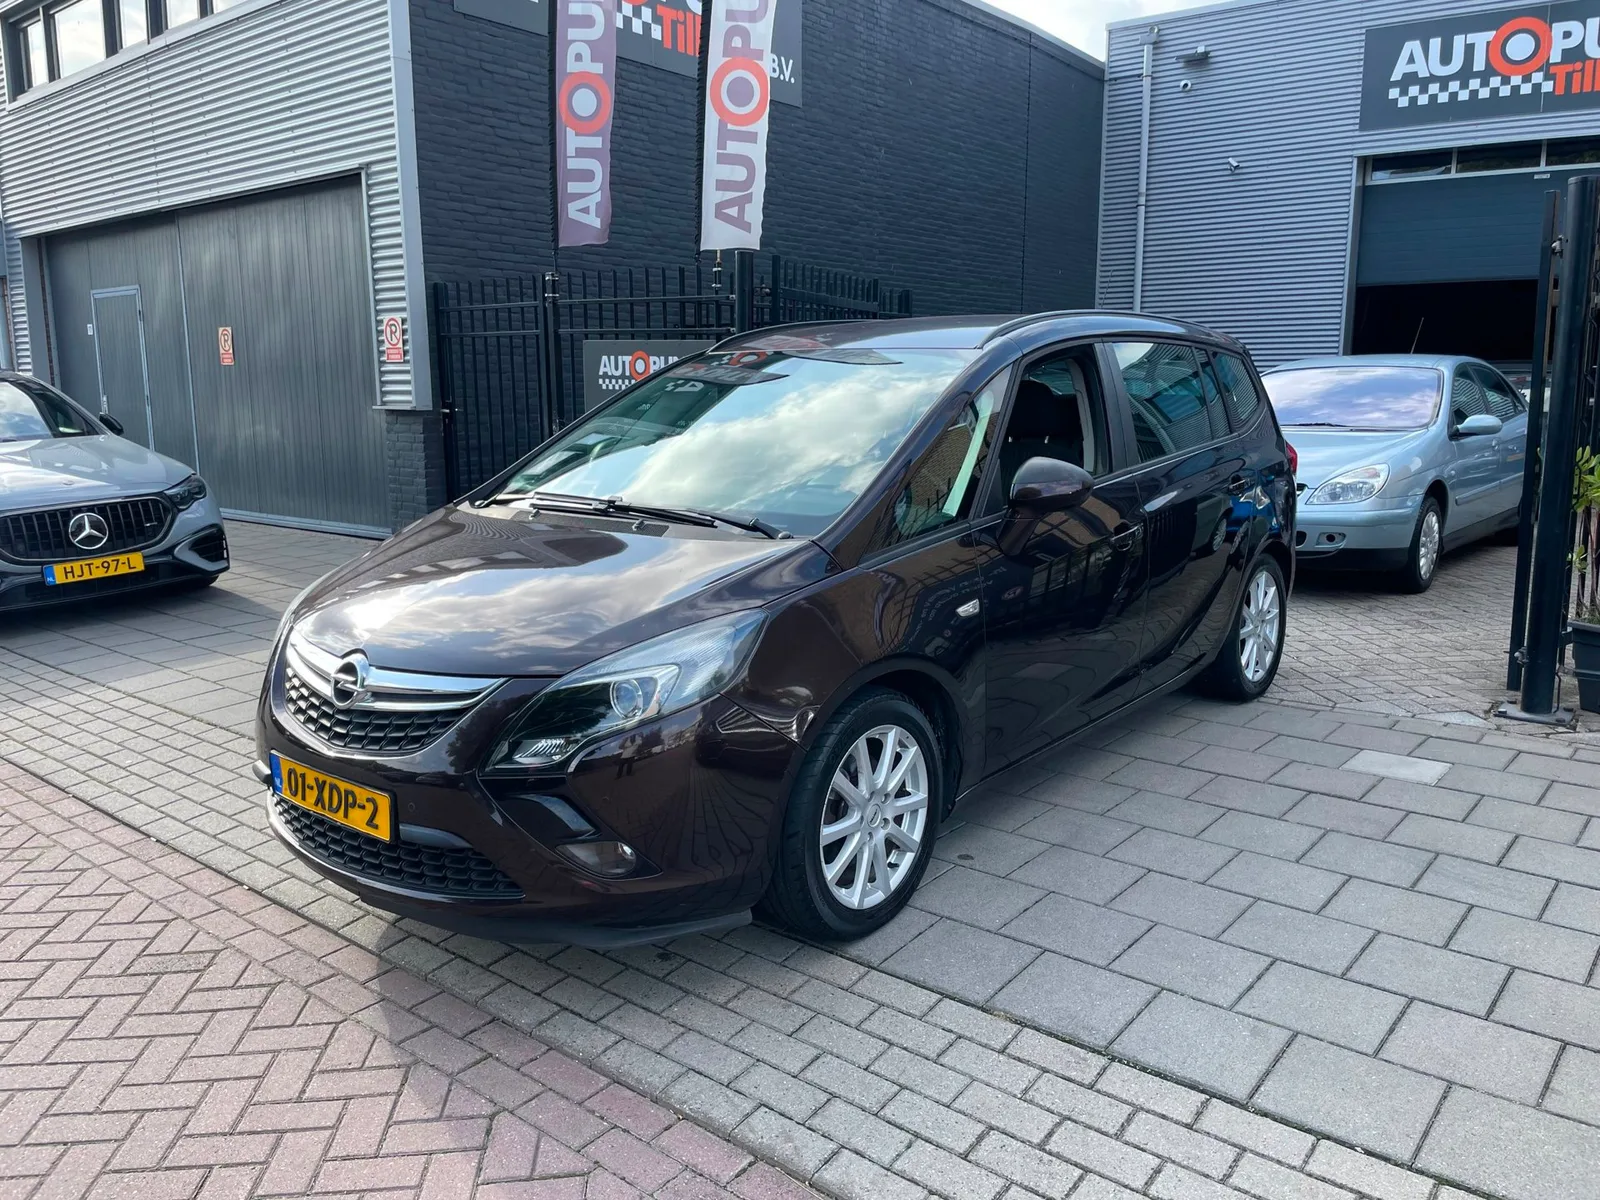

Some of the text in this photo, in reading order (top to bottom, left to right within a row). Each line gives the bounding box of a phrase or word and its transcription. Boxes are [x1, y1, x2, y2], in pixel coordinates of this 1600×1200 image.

[770, 53, 795, 84] B.V.
[599, 350, 680, 382] AUTOP
[63, 558, 137, 580] HJT-97-L
[287, 767, 379, 830] 01-XDP-2
